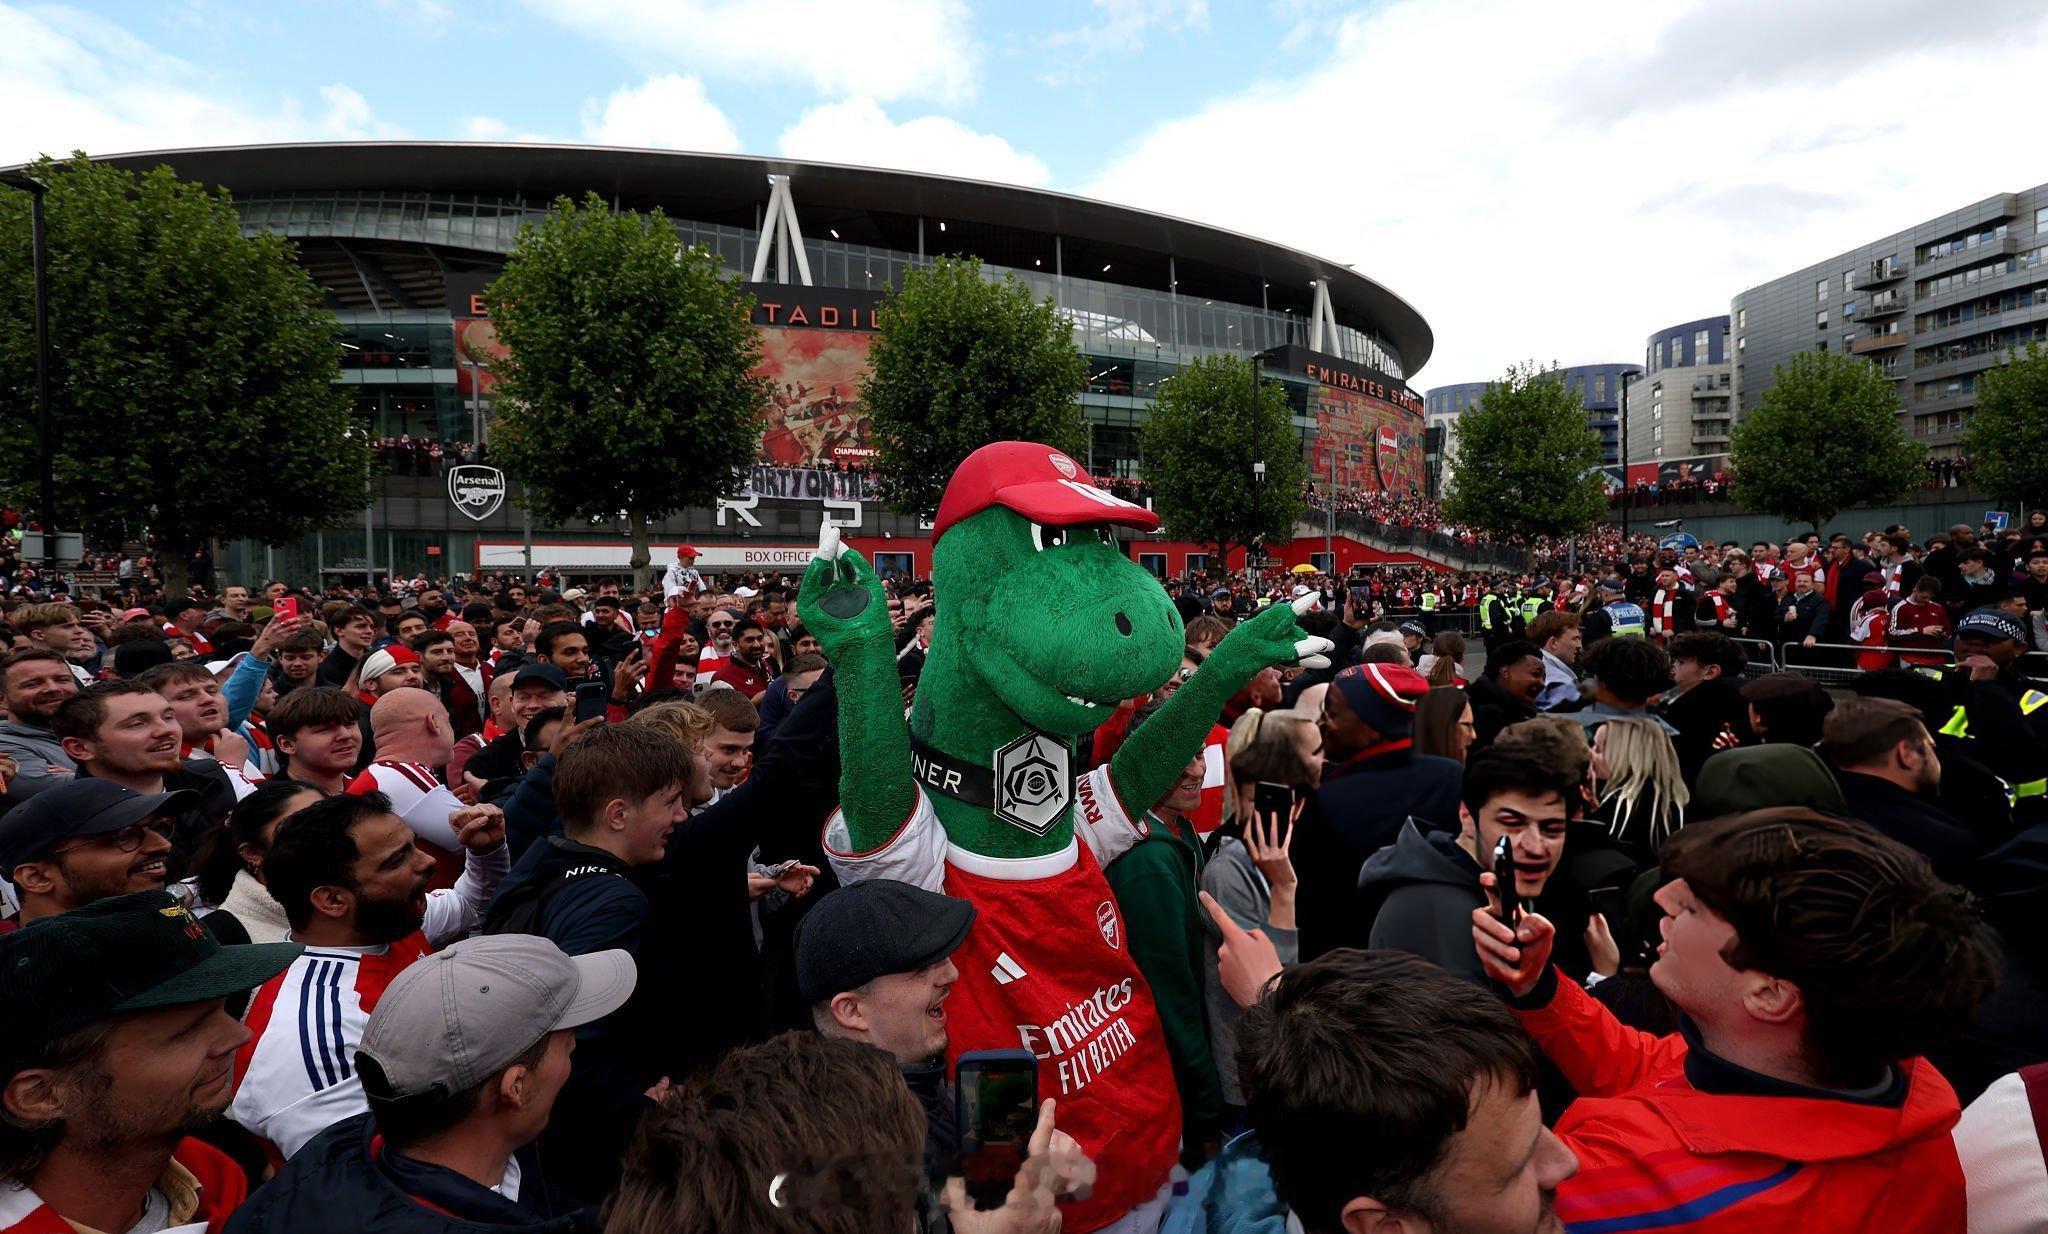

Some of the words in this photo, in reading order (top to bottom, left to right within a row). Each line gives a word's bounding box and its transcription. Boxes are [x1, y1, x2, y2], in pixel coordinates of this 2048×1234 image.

[1307, 363, 1385, 399] EMIRATES
[833, 447, 875, 457] CHAPMAN'S
[456, 475, 498, 486] Arsenal
[751, 467, 803, 498] ARTY
[805, 469, 835, 499] ON
[745, 551, 770, 563] BOX
[773, 551, 811, 563] OFFICE
[911, 750, 962, 794] NER
[565, 866, 608, 879] NIKE
[1016, 977, 1132, 1061] Emirates
[1058, 1048, 1092, 1095] FLY
[1087, 1017, 1137, 1074] BETTER
